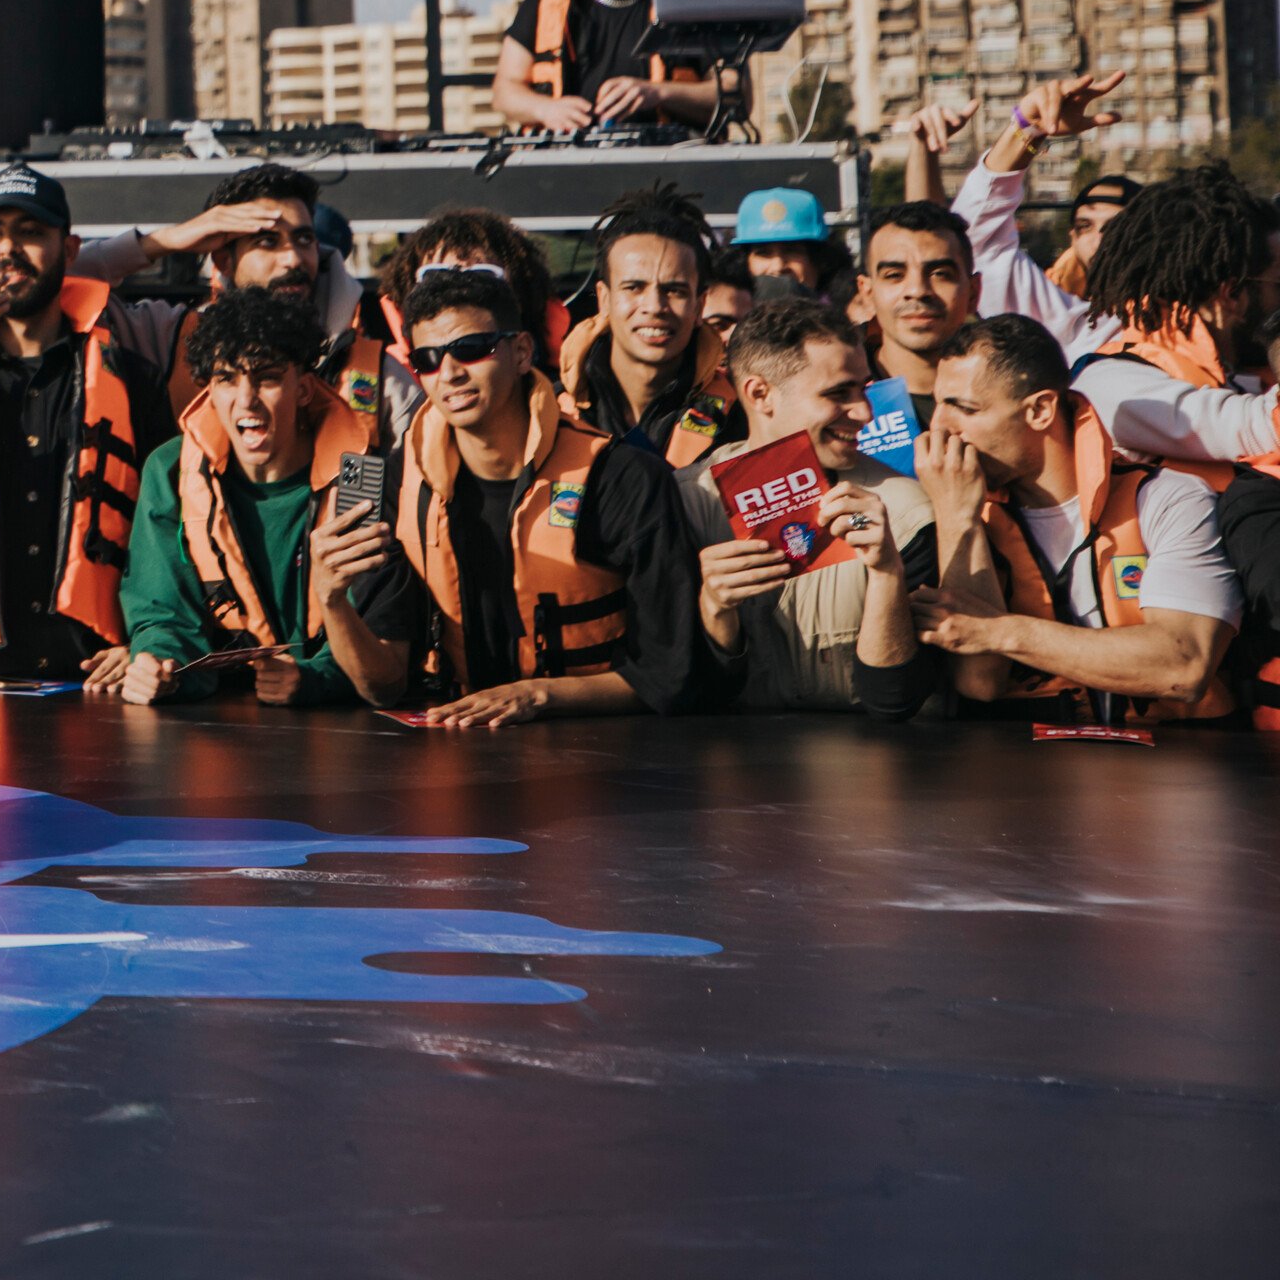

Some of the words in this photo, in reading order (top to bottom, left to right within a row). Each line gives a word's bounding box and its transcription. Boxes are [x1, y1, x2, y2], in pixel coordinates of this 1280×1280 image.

[856, 410, 908, 442] LUE
[734, 467, 818, 514] RED
[743, 499, 791, 522] RULES
[792, 486, 821, 503] THE
[746, 509, 785, 528] DANCE
